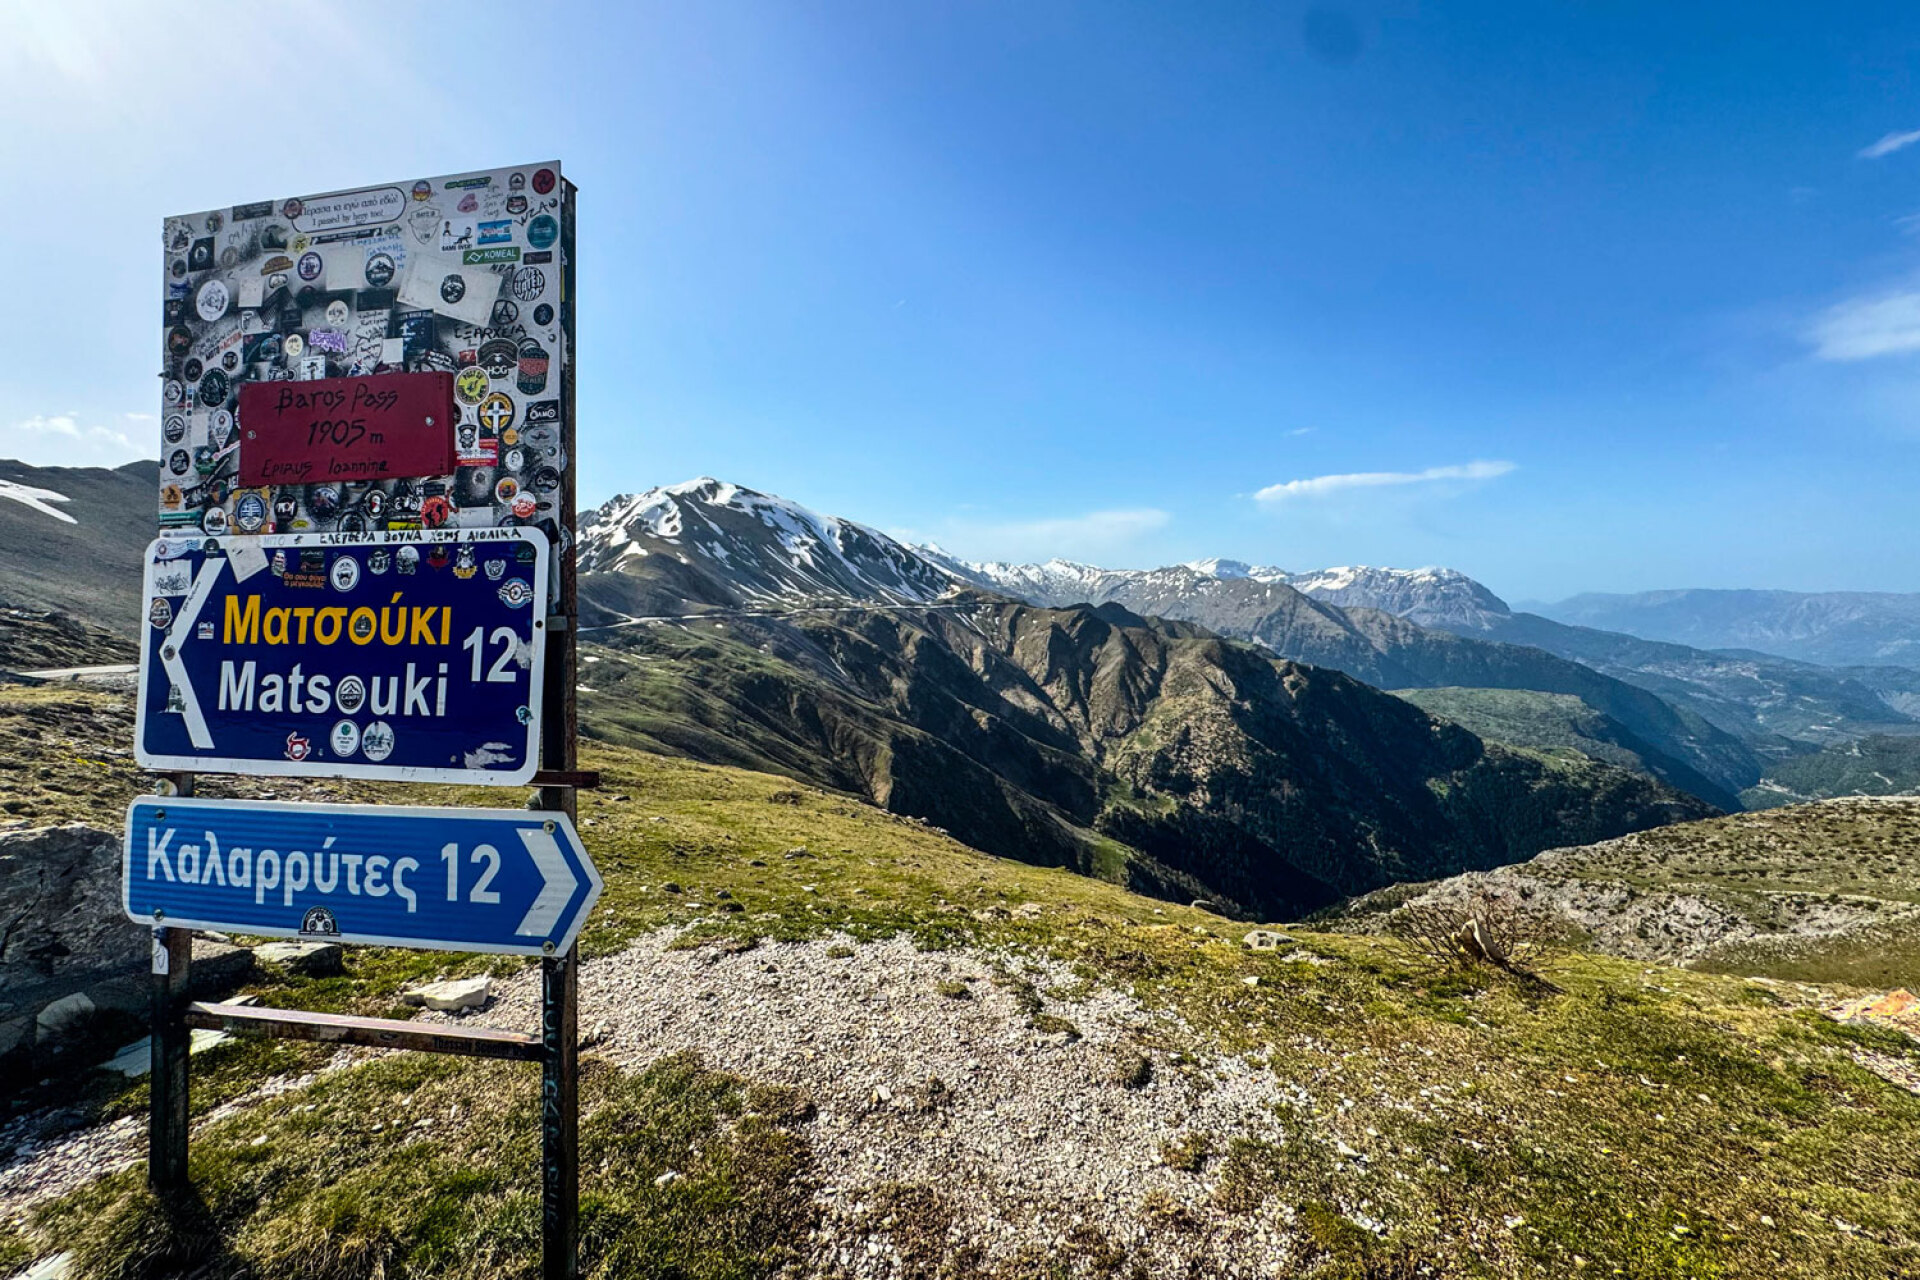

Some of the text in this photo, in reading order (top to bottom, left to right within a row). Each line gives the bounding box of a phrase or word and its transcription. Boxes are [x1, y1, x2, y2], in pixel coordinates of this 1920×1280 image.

[484, 249, 517, 259] KOMEAL
[487, 365, 508, 376] HOG
[274, 382, 399, 417] Baros Pass
[307, 418, 366, 449] 1905
[223, 591, 452, 646] Ματσούκι
[462, 626, 518, 683] 12
[146, 826, 501, 913] Καλαρρύτες 12
